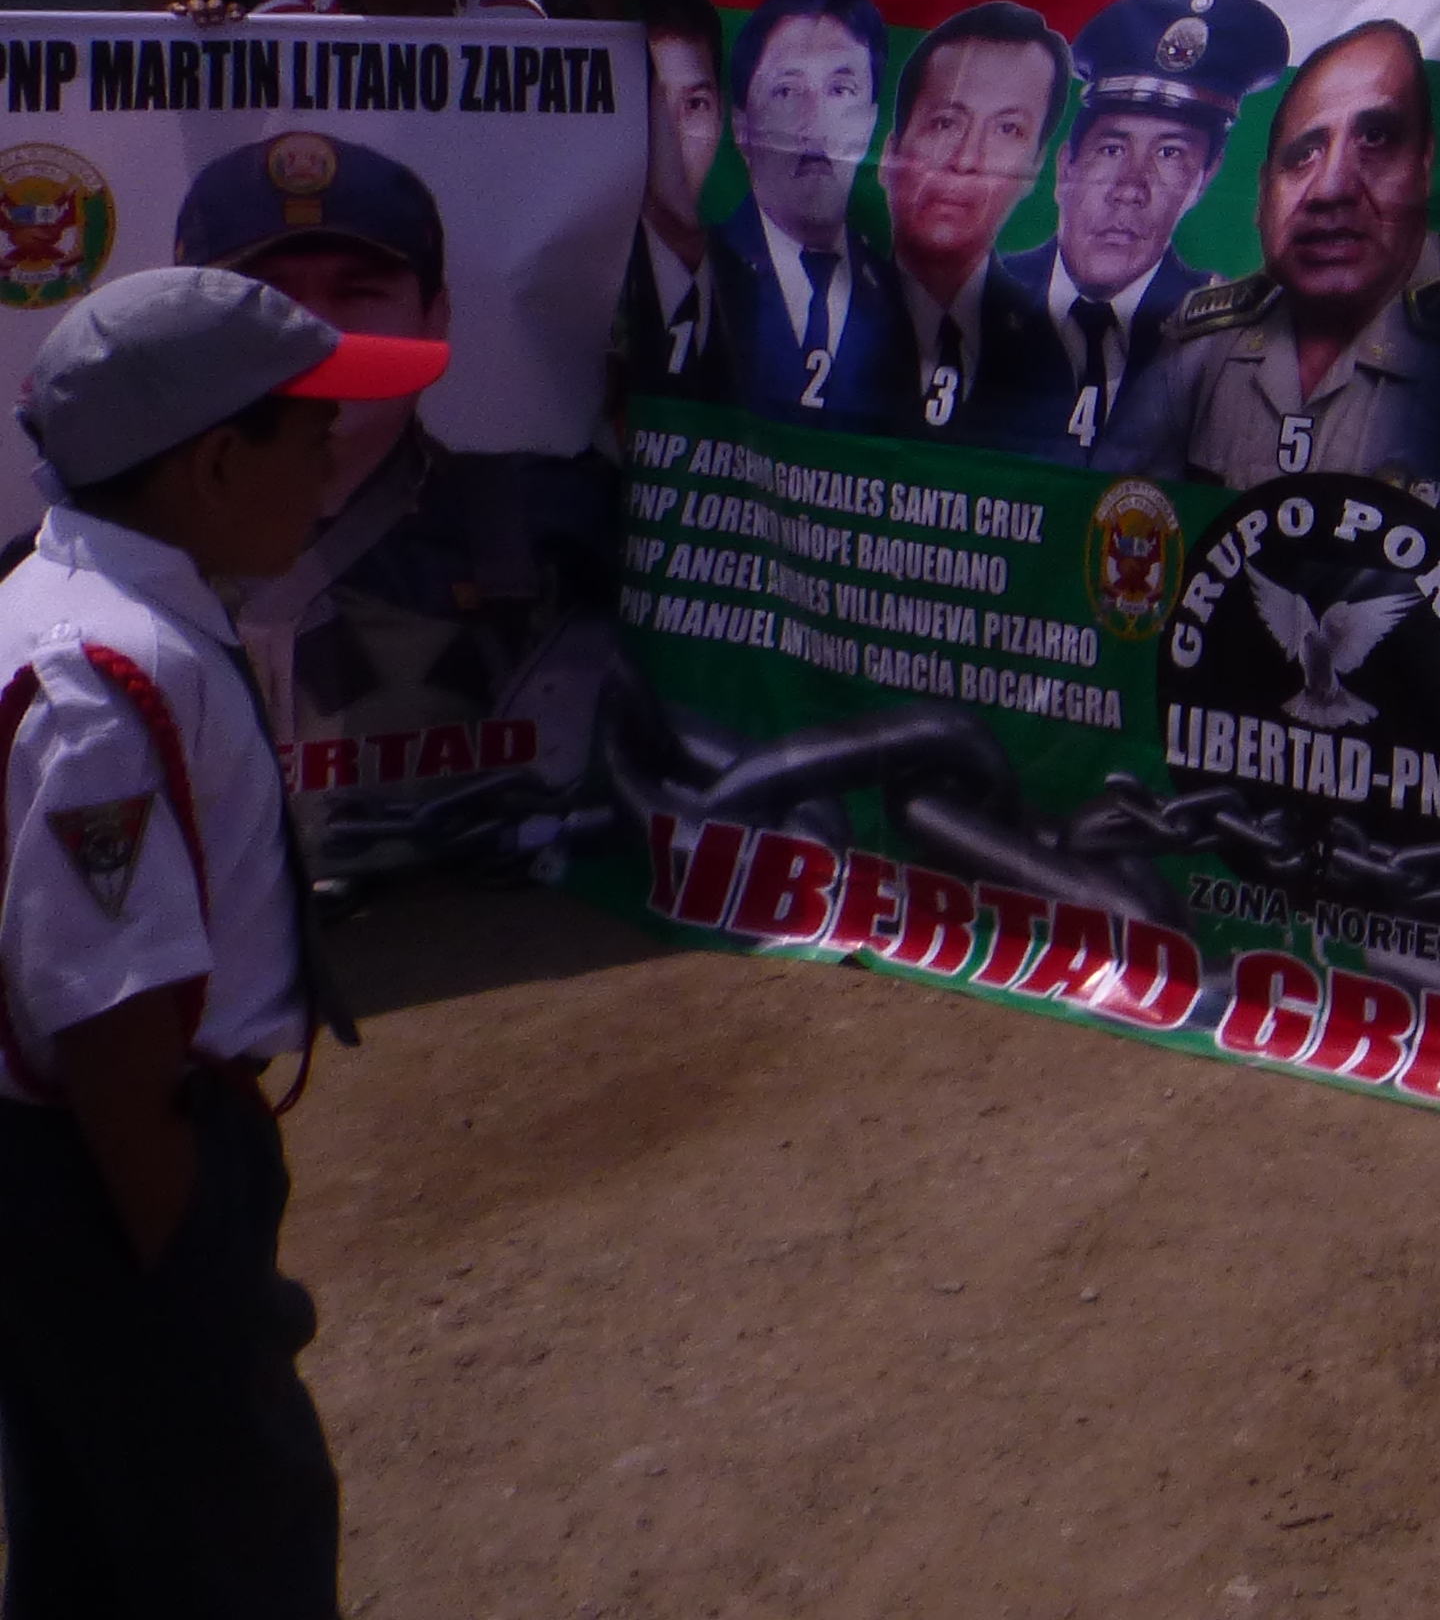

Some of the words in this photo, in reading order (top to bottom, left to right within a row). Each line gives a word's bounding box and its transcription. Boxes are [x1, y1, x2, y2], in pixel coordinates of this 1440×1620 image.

[0, 40, 77, 113] NP
[89, 39, 280, 112] MARTIN
[292, 40, 449, 112] LITANO
[459, 44, 617, 115] ZAPATA
[800, 346, 835, 411] 2
[923, 363, 961, 428] 3
[1066, 381, 1102, 448] 4
[1275, 412, 1317, 475] 5
[774, 461, 886, 518] GONZALES
[889, 481, 969, 533] SANTA
[975, 498, 1044, 545] CRUZ
[857, 533, 1010, 596] BAQUEDANO
[1171, 496, 1316, 669] GRUPO
[664, 542, 764, 592] ANGEL
[834, 581, 978, 647] VILLANUEVA
[983, 610, 1099, 669] PIZARRO
[653, 593, 777, 650] MANUEL
[960, 661, 1124, 732] BOCANEGRA
[647, 812, 1201, 1031] LIBERTAD
